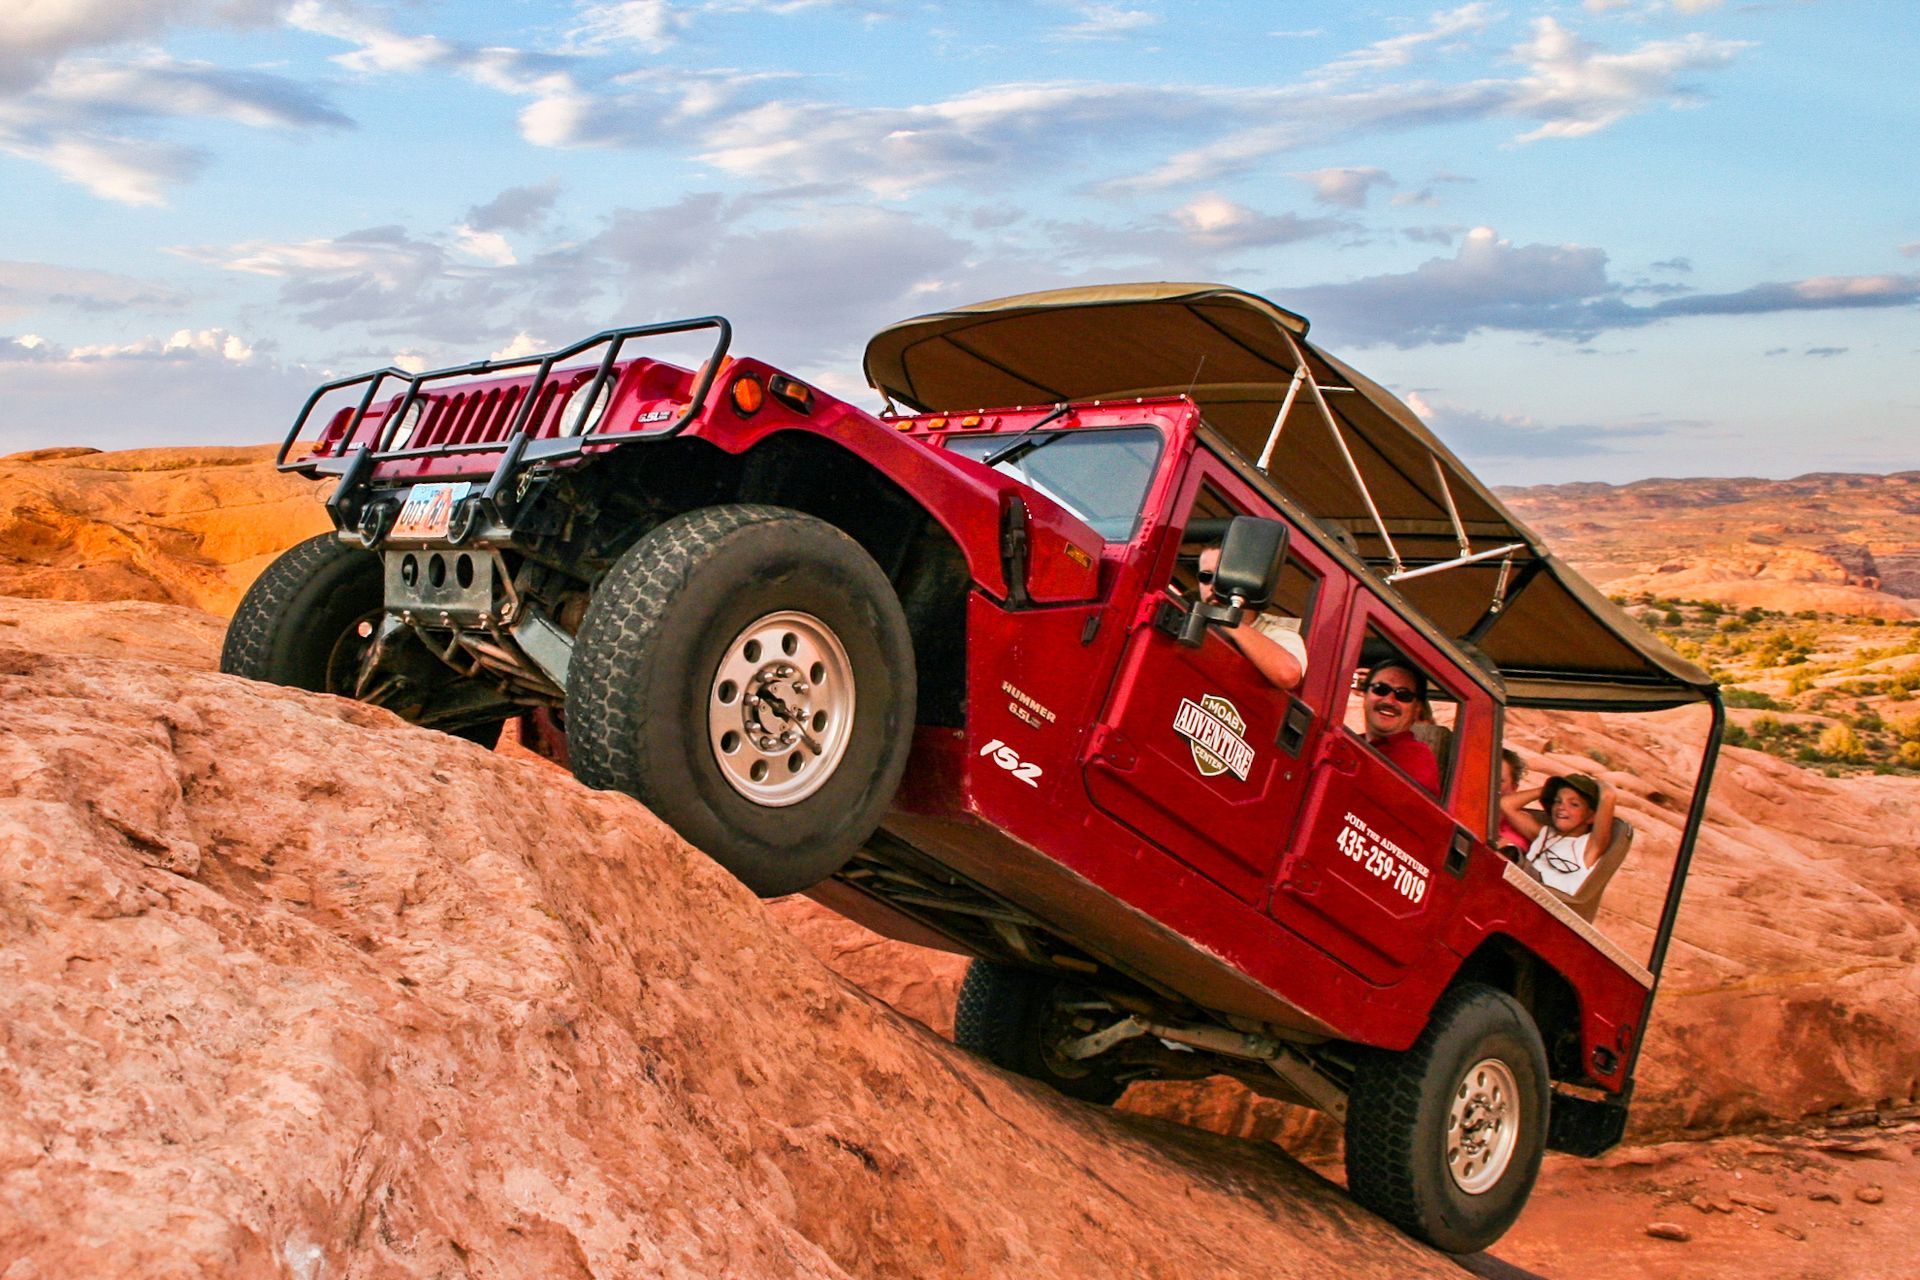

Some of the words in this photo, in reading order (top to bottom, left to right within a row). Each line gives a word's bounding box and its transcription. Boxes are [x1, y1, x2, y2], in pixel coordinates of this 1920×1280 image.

[1001, 680, 1056, 724] HUMMER
[1208, 699, 1239, 730] MOAB
[1176, 703, 1252, 772] ADVENTURE
[1194, 745, 1223, 770] CENTER
[980, 738, 1043, 788] 152
[1336, 826, 1426, 903] 435-259-7019
[1344, 811, 1367, 832] JOIN
[1366, 827, 1381, 843] THE
[1379, 837, 1430, 878] ADVENTURE
